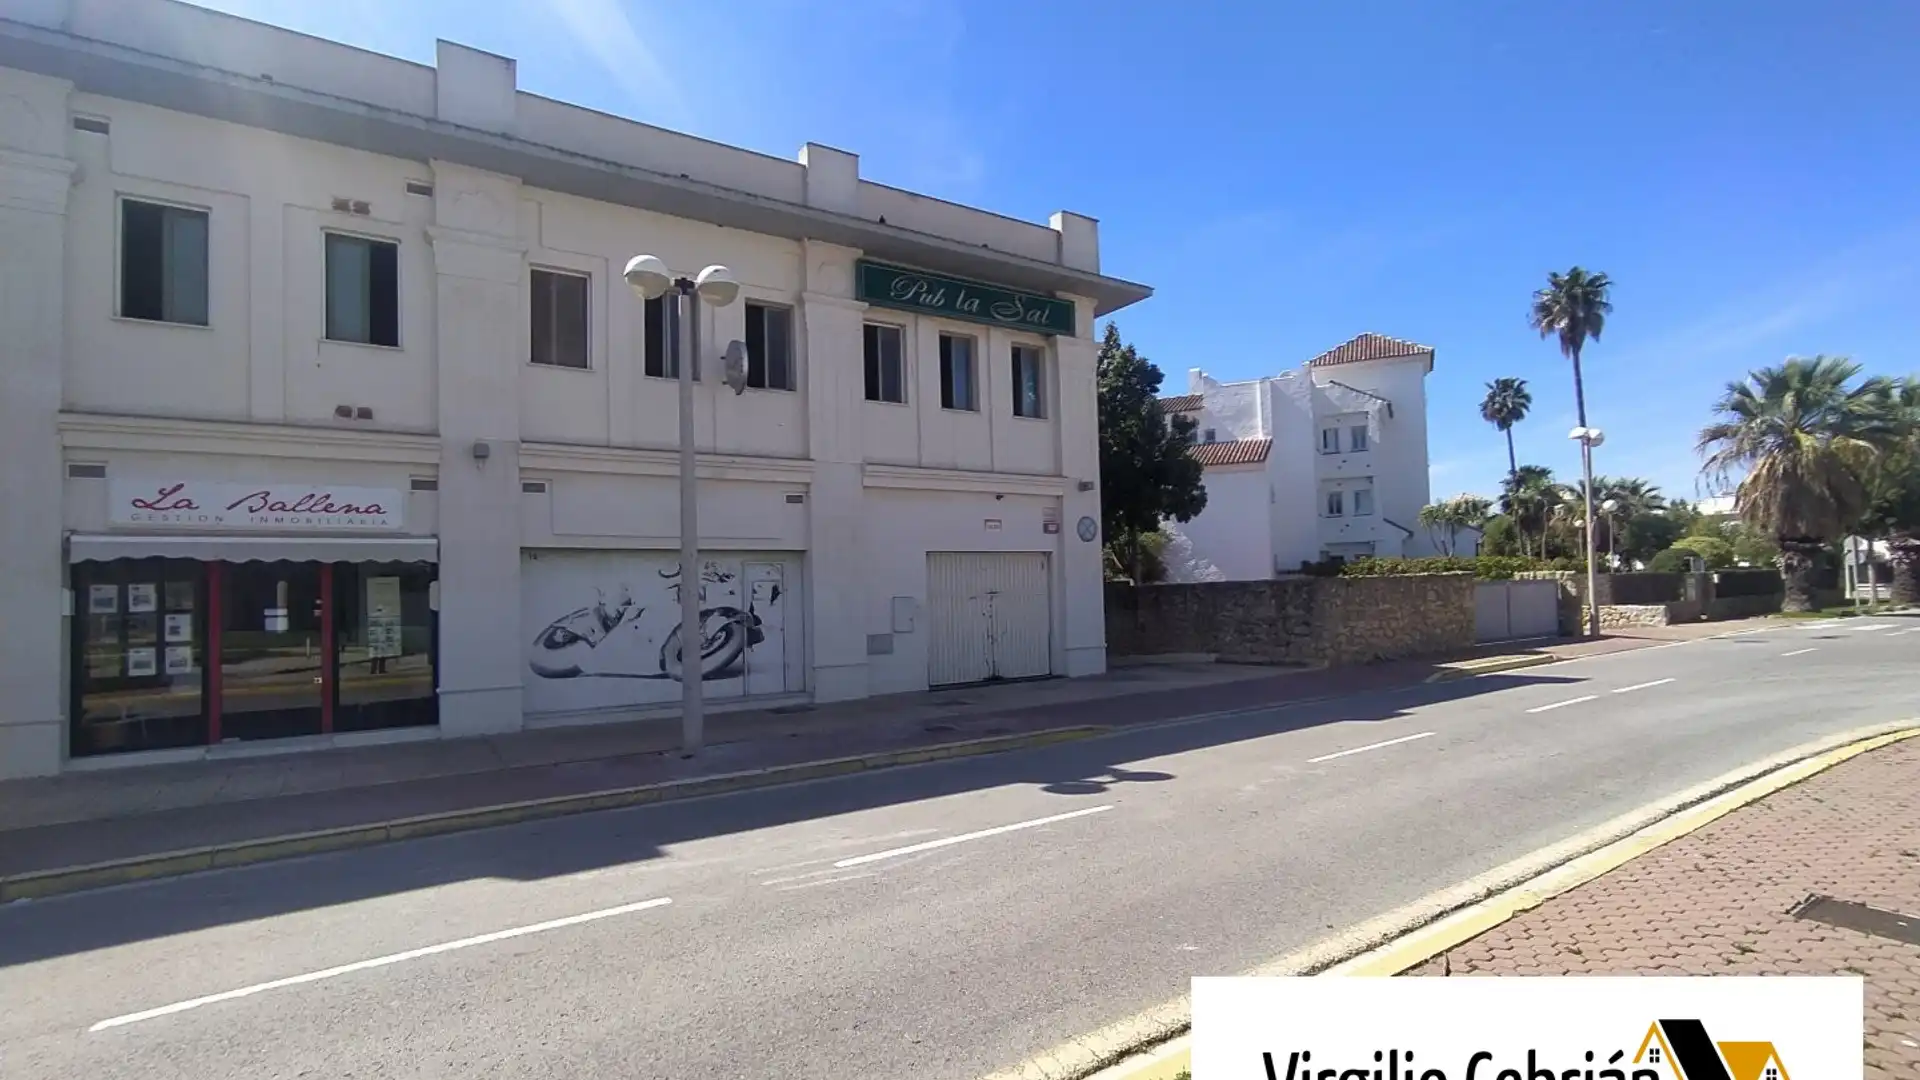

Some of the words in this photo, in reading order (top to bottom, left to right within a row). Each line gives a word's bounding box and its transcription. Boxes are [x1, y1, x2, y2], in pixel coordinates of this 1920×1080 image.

[890, 275, 946, 307] Pub
[956, 289, 980, 312] la
[990, 294, 1049, 324] Sal
[131, 483, 199, 511] La
[226, 491, 388, 515] Ballena
[250, 516, 388, 525] INMOBILIARIA
